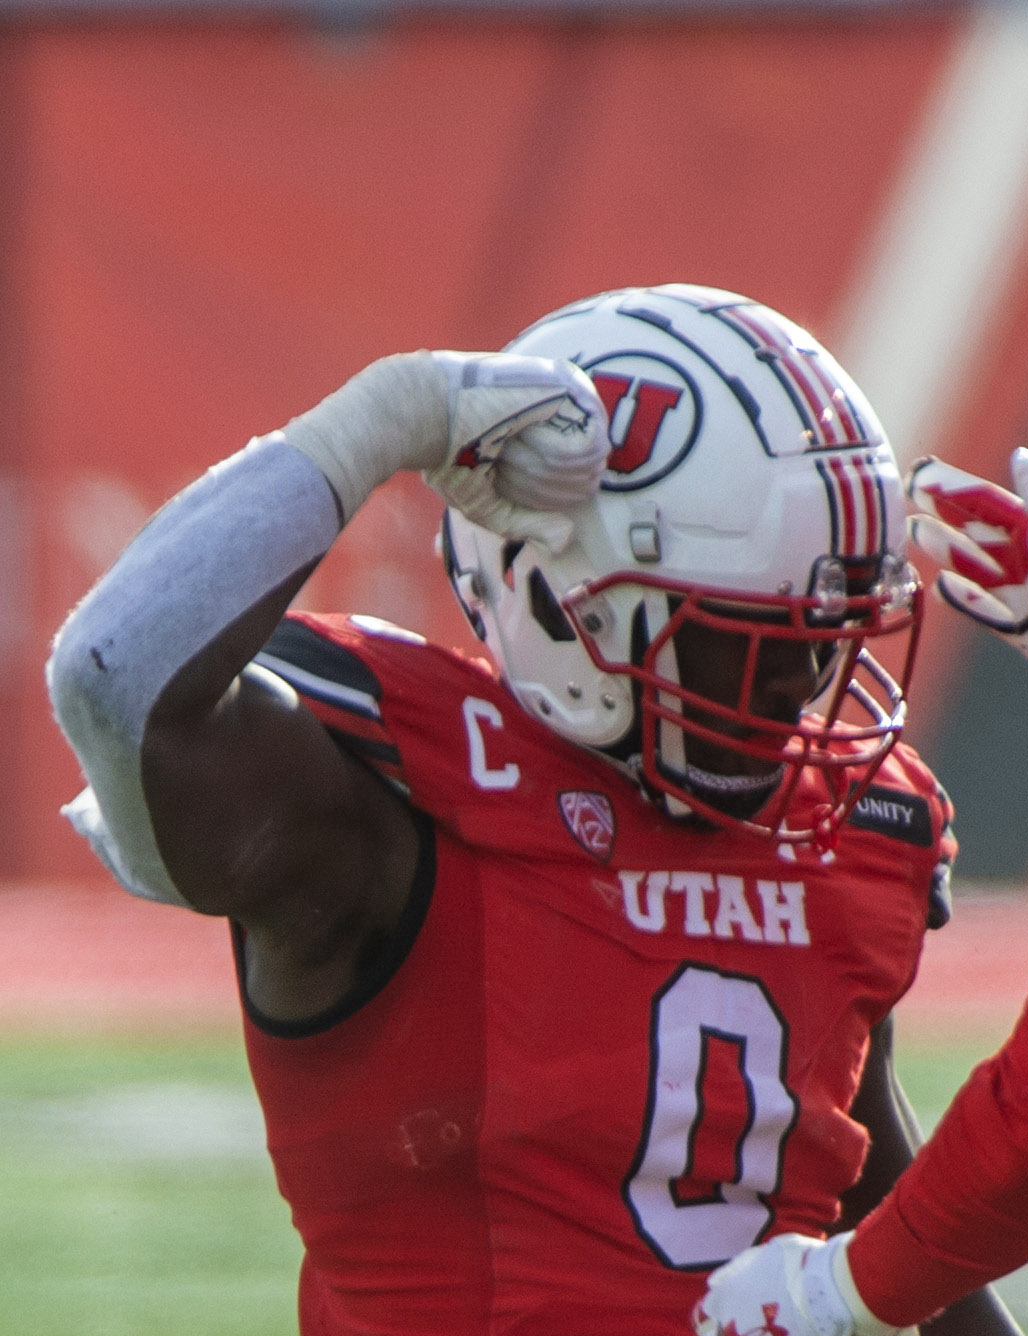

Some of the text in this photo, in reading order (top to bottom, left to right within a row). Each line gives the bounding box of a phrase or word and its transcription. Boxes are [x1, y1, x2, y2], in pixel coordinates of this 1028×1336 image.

[462, 695, 521, 790] C
[618, 869, 812, 946] UTAH
[620, 959, 800, 1272] 0
